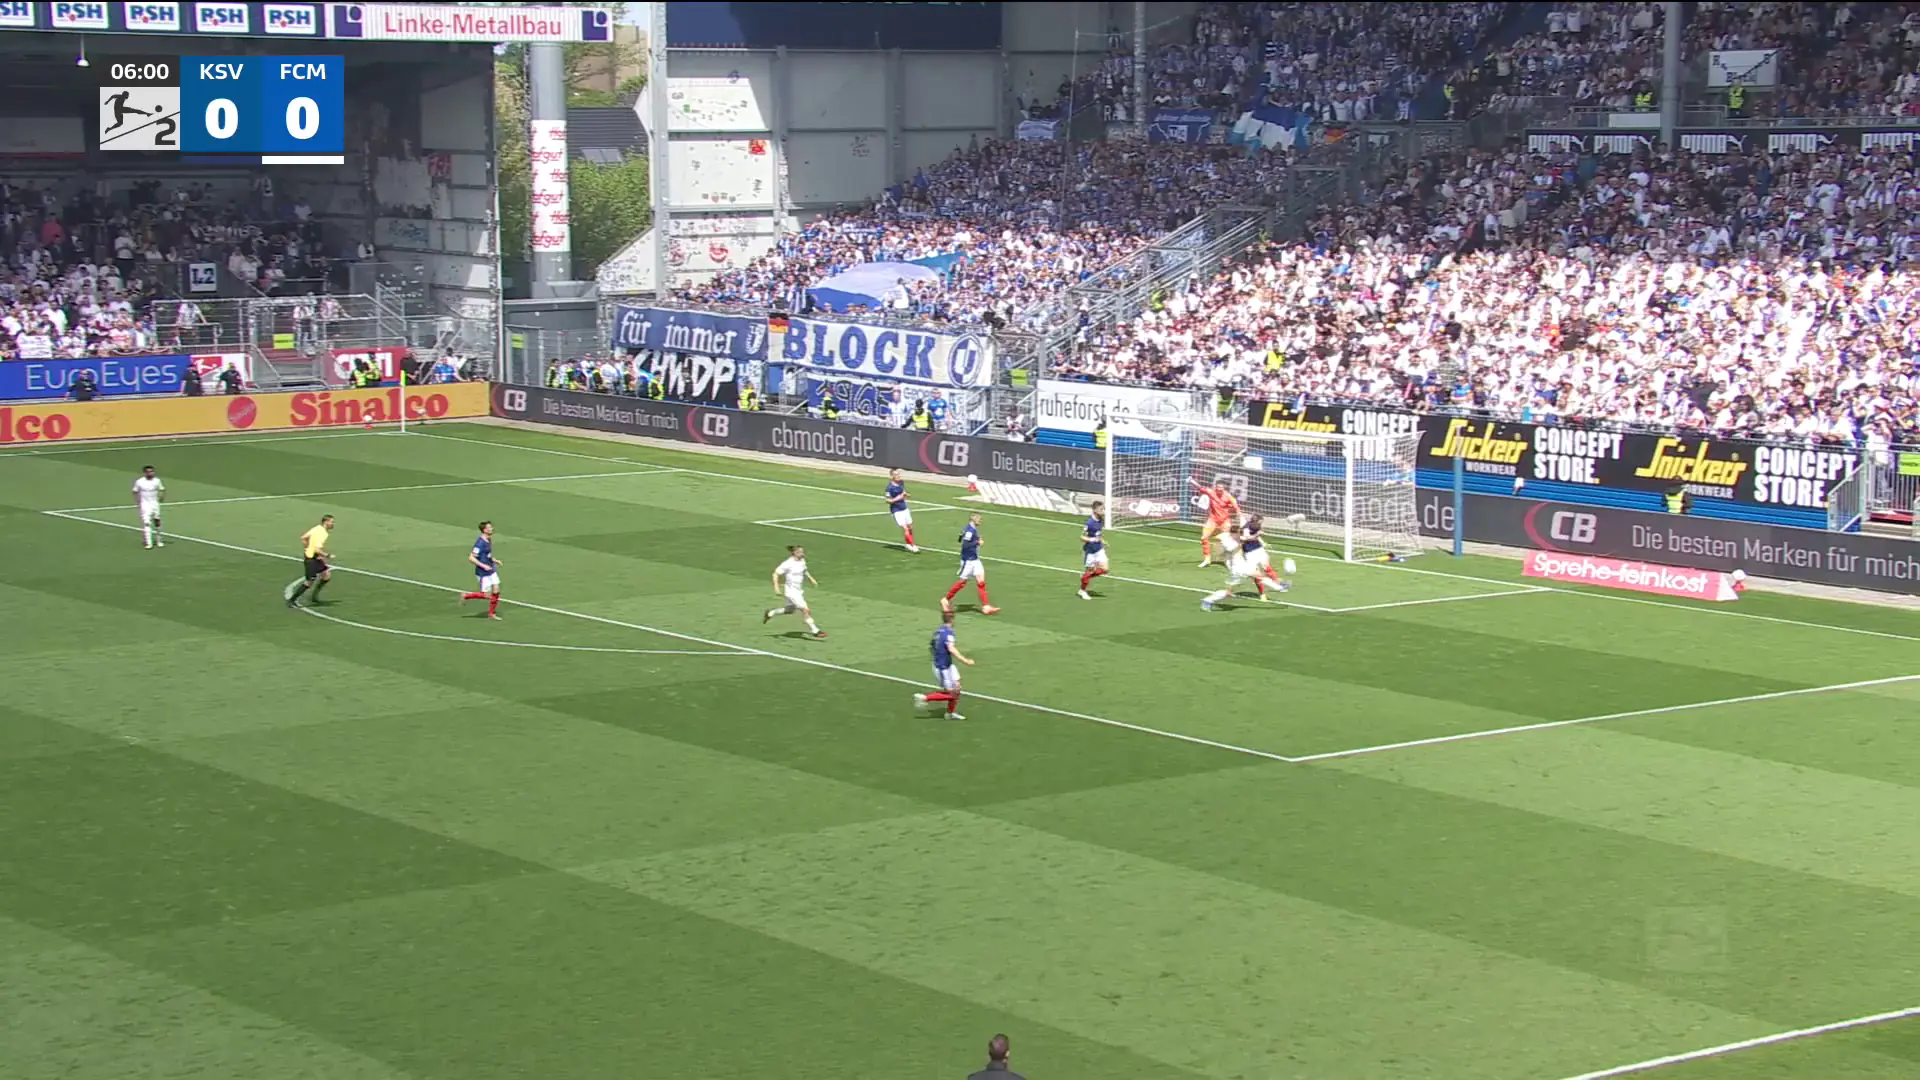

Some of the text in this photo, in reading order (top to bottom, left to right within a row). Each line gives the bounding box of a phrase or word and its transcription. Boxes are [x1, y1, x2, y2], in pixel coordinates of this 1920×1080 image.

[56, 3, 104, 20] RSH
[130, 5, 175, 22] RSH
[201, 7, 245, 24] RSH
[269, 10, 311, 26] RSH
[384, 12, 562, 36] Linke-Metallbau
[619, 310, 738, 354] für immer
[782, 318, 936, 378] BLOCK
[26, 360, 177, 393] EuroEyes
[290, 387, 449, 425] Sinalco
[503, 389, 527, 412] CB
[543, 397, 679, 430] Die besten Marken für mich
[703, 413, 729, 438] CB
[772, 421, 874, 459] cbmode.de
[1342, 409, 1420, 438] CONCEPT
[938, 440, 969, 467] CB
[1430, 418, 1528, 464] Snickers
[1533, 426, 1623, 460] CONCEPT
[992, 451, 1013, 470] Die
[1015, 454, 1061, 478] besten
[1065, 460, 1105, 482] Marke
[1465, 461, 1516, 476] WORKWEAR
[1636, 437, 1748, 486] Snickers
[1754, 446, 1858, 481] CONCEPT
[1682, 484, 1734, 499] ORKWEAR
[1550, 511, 1597, 545] CB
[1632, 524, 1920, 581] Die besten Marken für mich
[1533, 553, 1709, 593] Sprehe-feinkost
